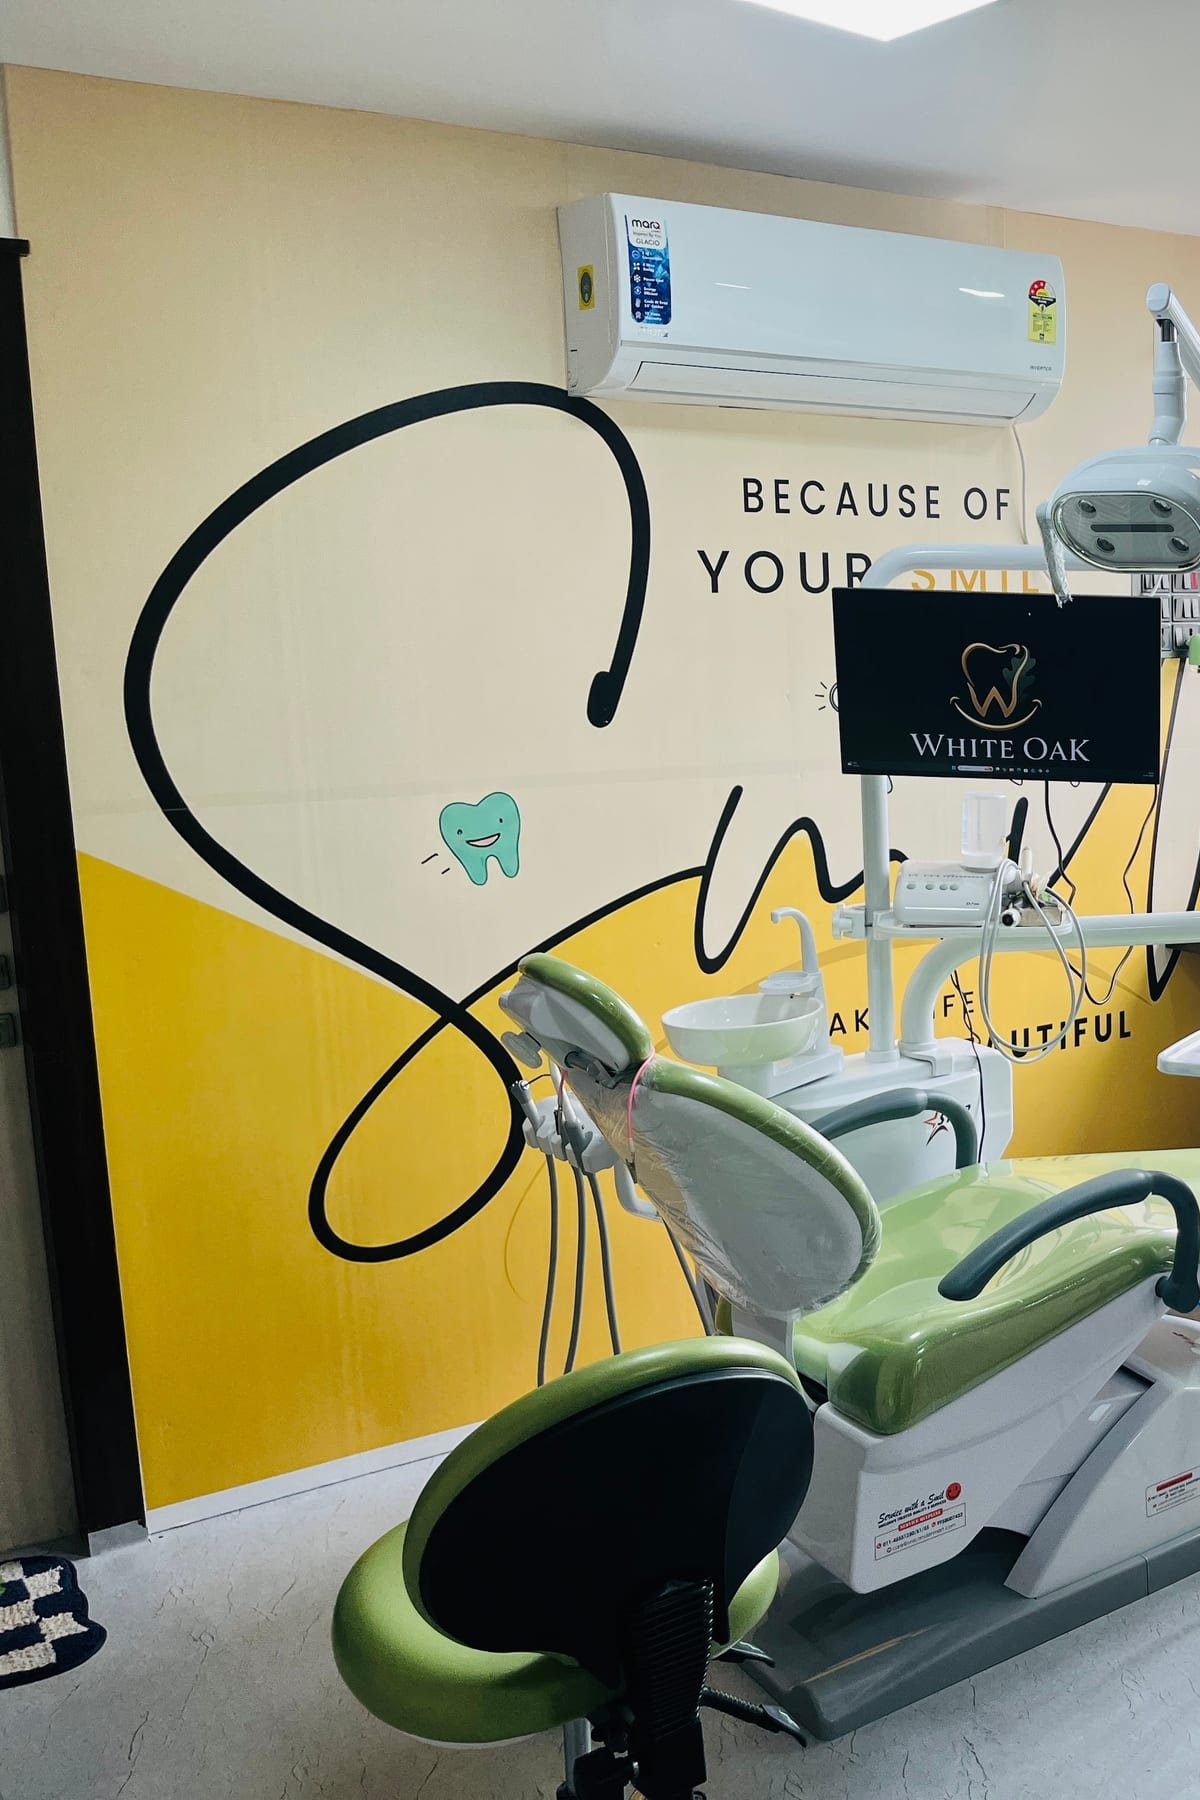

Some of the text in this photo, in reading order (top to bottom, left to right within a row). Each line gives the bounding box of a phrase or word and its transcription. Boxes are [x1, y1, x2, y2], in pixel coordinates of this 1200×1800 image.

[742, 477, 1011, 521] BECAUSE OF
[697, 549, 1056, 594] YOUR SMIL
[904, 1499, 920, 1513] with
